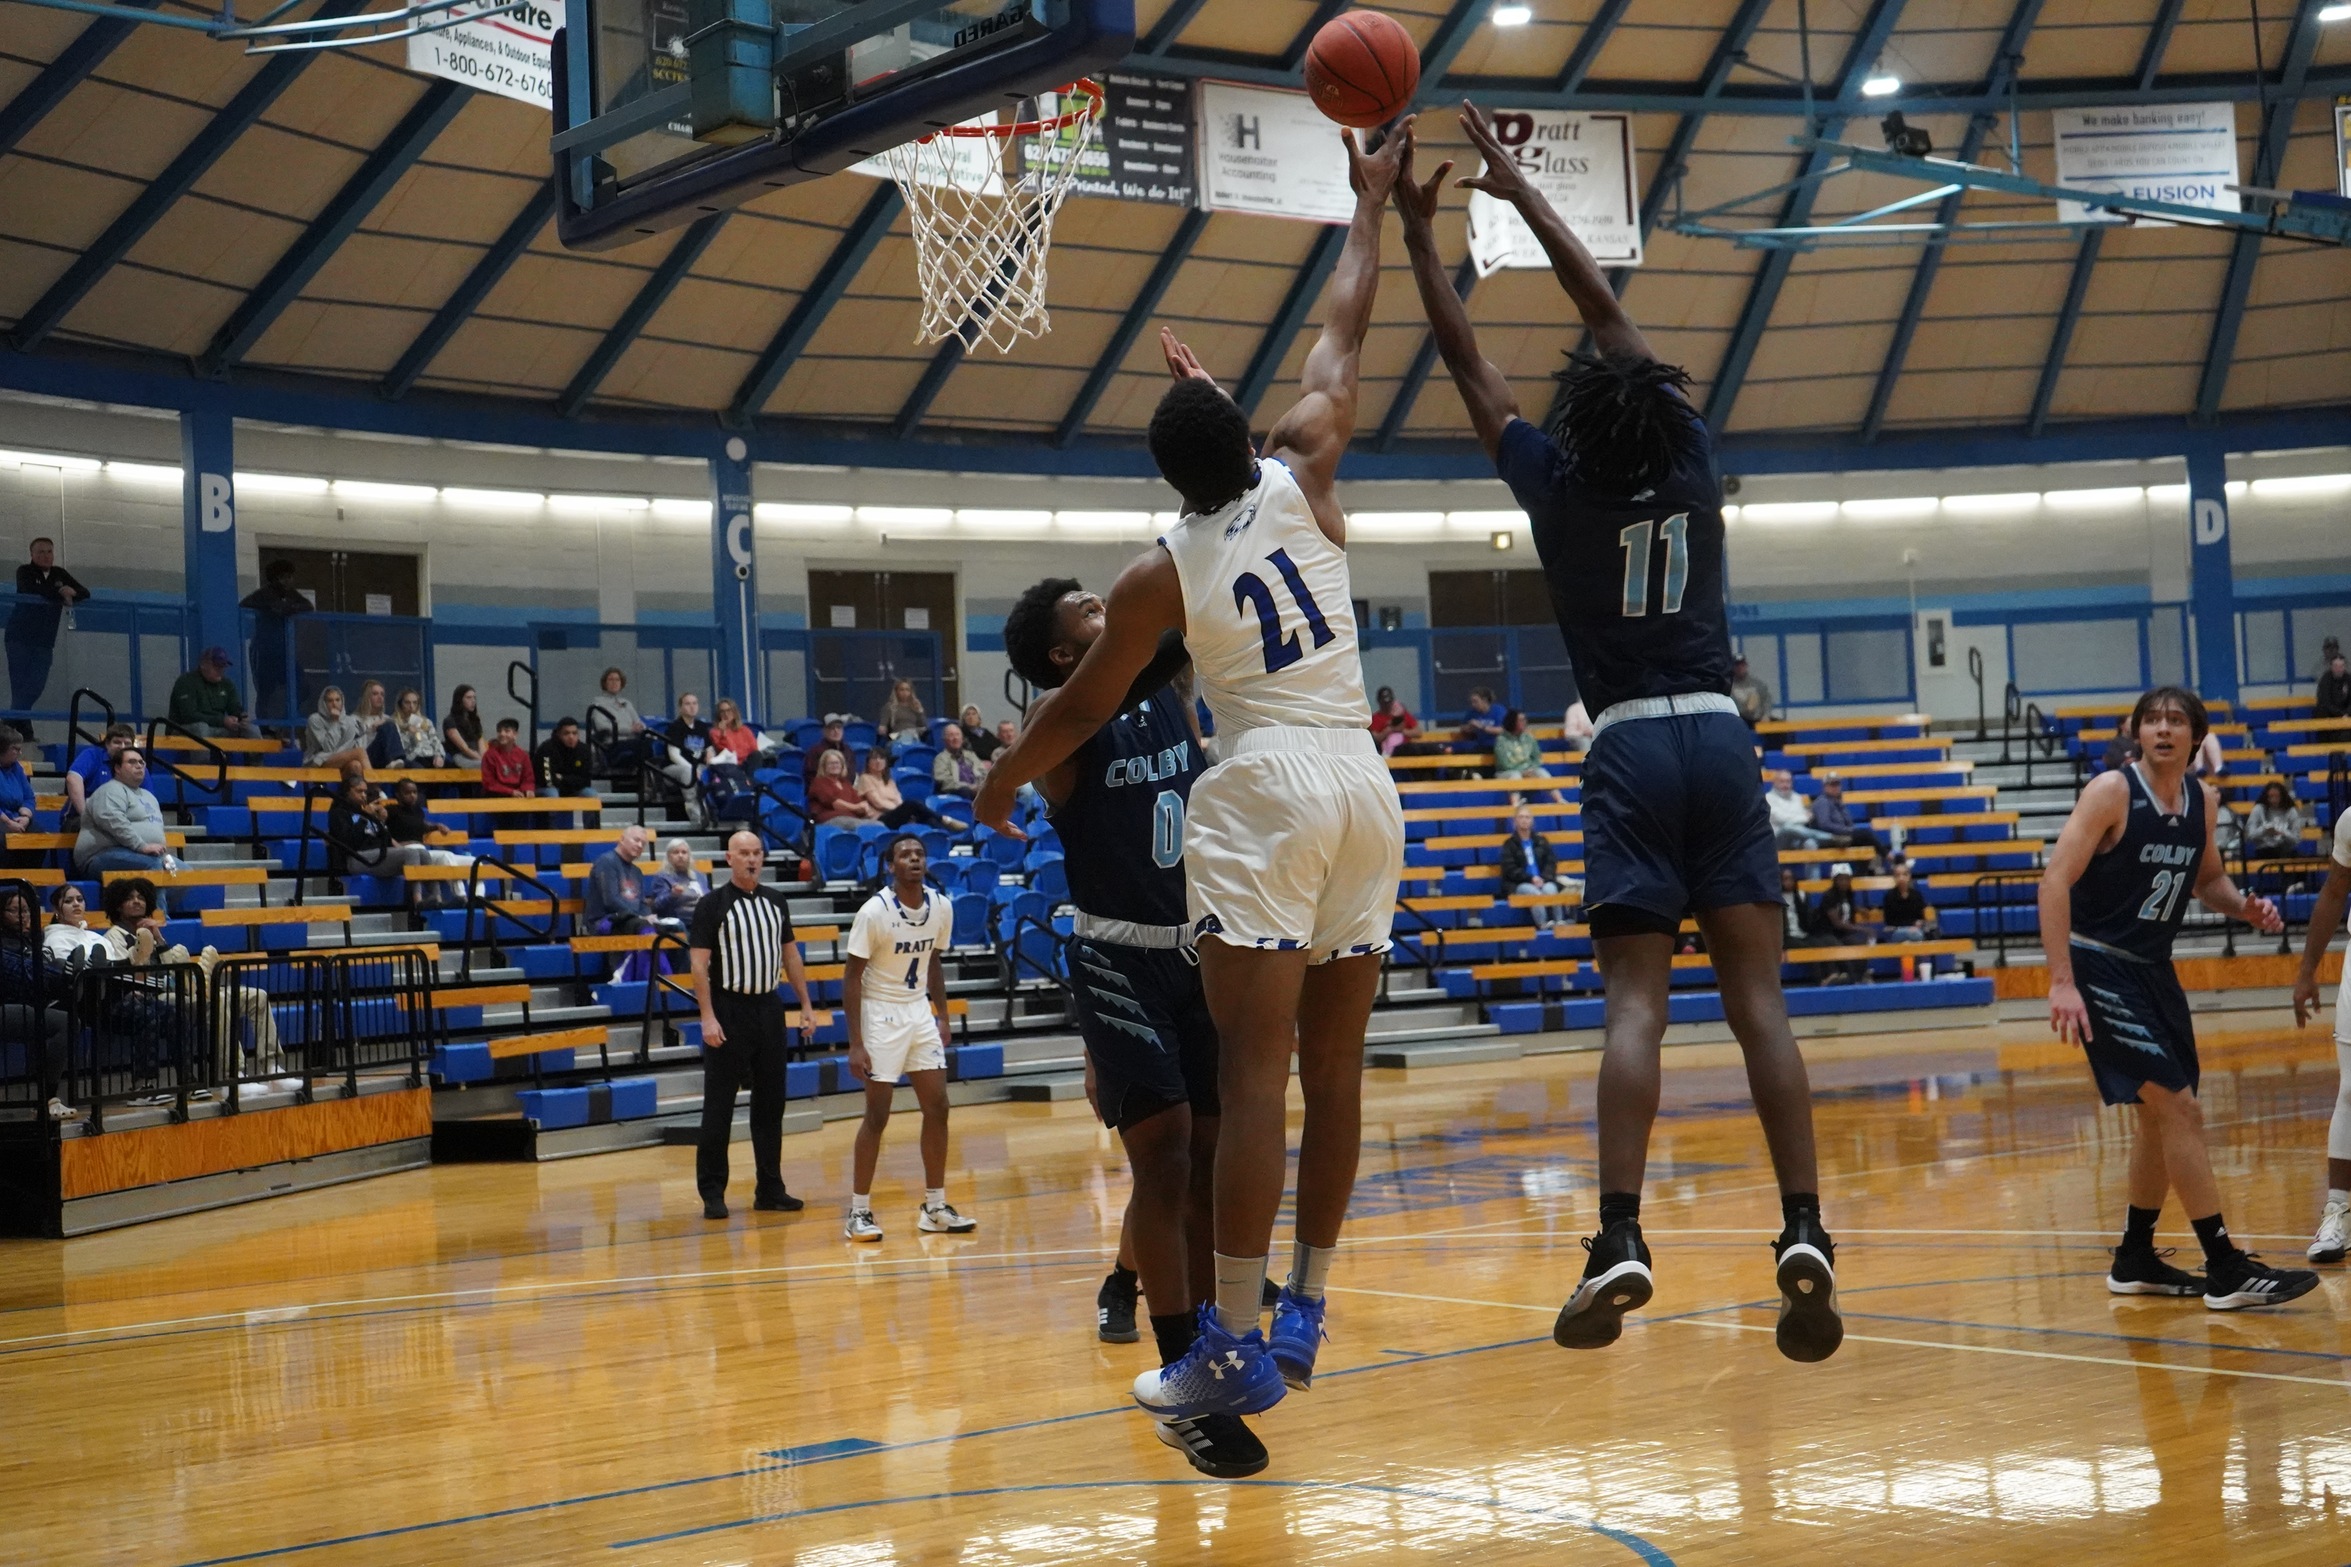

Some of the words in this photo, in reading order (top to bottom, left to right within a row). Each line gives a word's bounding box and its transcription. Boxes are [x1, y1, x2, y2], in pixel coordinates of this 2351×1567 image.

[504, 43, 531, 64] Outdoor
[1492, 113, 1581, 146] Pratt
[2101, 113, 2129, 126] make
[2133, 111, 2174, 128] banking
[1514, 147, 1590, 175] glass
[1122, 182, 1147, 198] We
[1148, 184, 1167, 199] do
[200, 472, 233, 533] B
[2194, 499, 2226, 545] D
[727, 513, 751, 565] C
[1619, 512, 1690, 617] 11
[1232, 547, 1337, 675] 21
[1105, 740, 1189, 788] COLBY
[1152, 789, 1185, 869] 0
[2139, 843, 2197, 867] COLBY
[2137, 869, 2187, 922] 21
[894, 938, 935, 954] PRATT
[904, 957, 920, 990] 4
